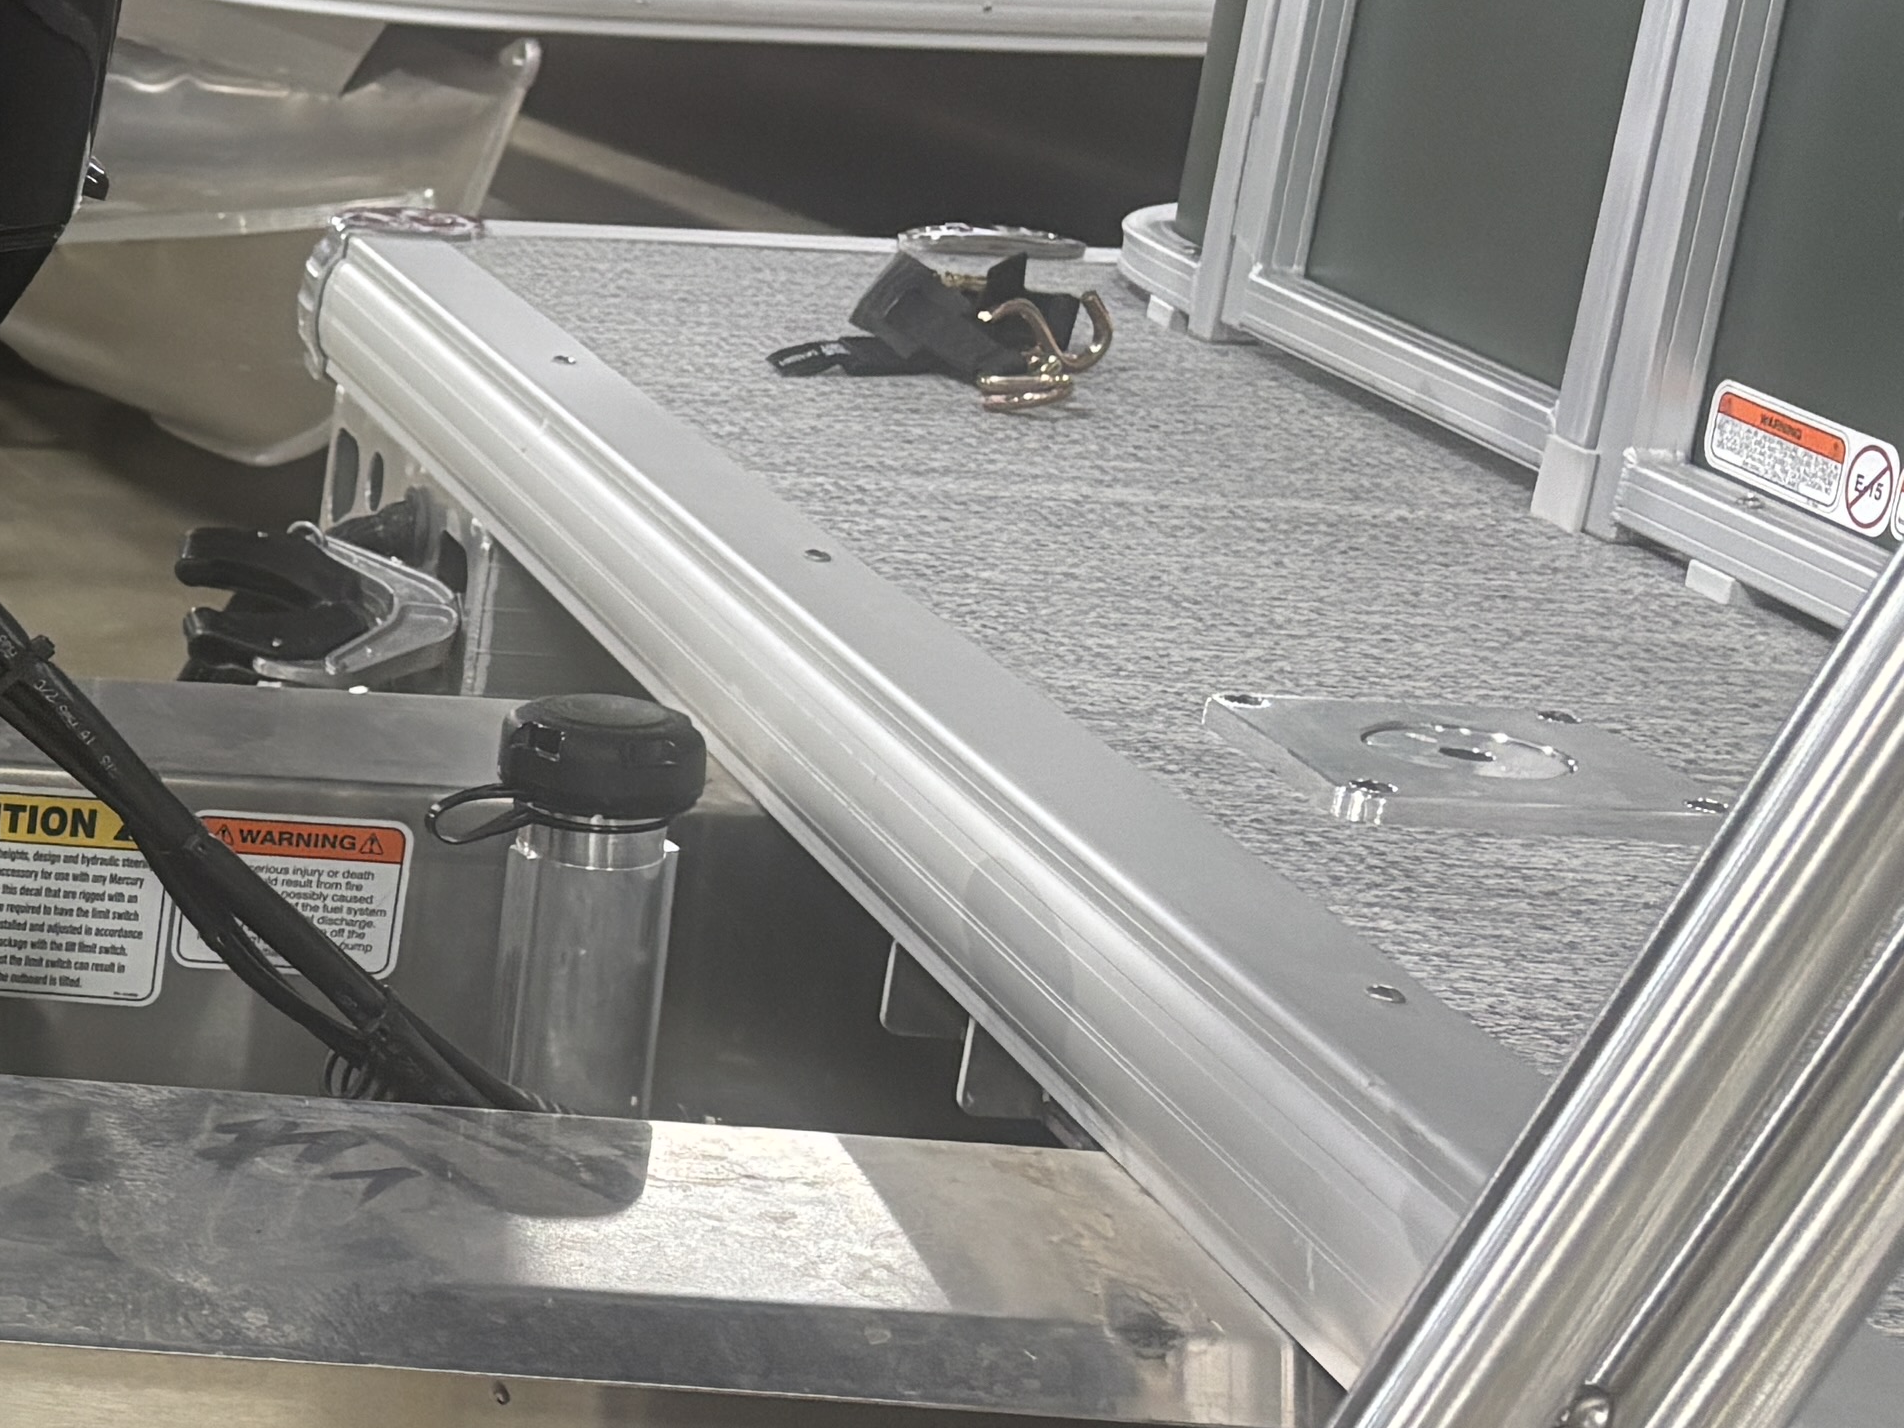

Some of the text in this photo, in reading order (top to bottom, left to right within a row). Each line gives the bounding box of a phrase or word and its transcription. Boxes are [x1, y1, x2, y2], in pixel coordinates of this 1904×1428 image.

[239, 828, 357, 851] WARNING
[33, 851, 61, 865] design
[63, 853, 79, 864] and
[81, 853, 120, 868] hydraulic
[122, 856, 153, 871] steerin
[41, 868, 53, 879] for
[72, 870, 90, 882] with
[92, 874, 107, 886] any
[109, 873, 145, 889] Mercury
[292, 865, 324, 879] injury
[327, 868, 340, 878] or
[342, 869, 375, 881] death
[281, 876, 313, 889] result
[2, 883, 18, 895] this
[19, 884, 43, 897] decal
[44, 886, 61, 899] that
[63, 889, 78, 900] are
[79, 889, 106, 903] rigged
[107, 891, 126, 903] with
[331, 893, 374, 905] caused
[6, 903, 41, 916] required
[43, 904, 52, 916] to
[53, 905, 74, 917] have
[76, 907, 90, 918] the
[91, 907, 110, 920] limit
[112, 910, 140, 922] switch
[301, 902, 387, 918] the fuel system
[29, 921, 45, 932] and
[47, 922, 83, 936] adjusted
[94, 926, 143, 940] accordance
[317, 915, 376, 930] discharge.
[347, 929, 366, 941] the
[49, 940, 63, 952] the
[73, 960, 89, 971] can
